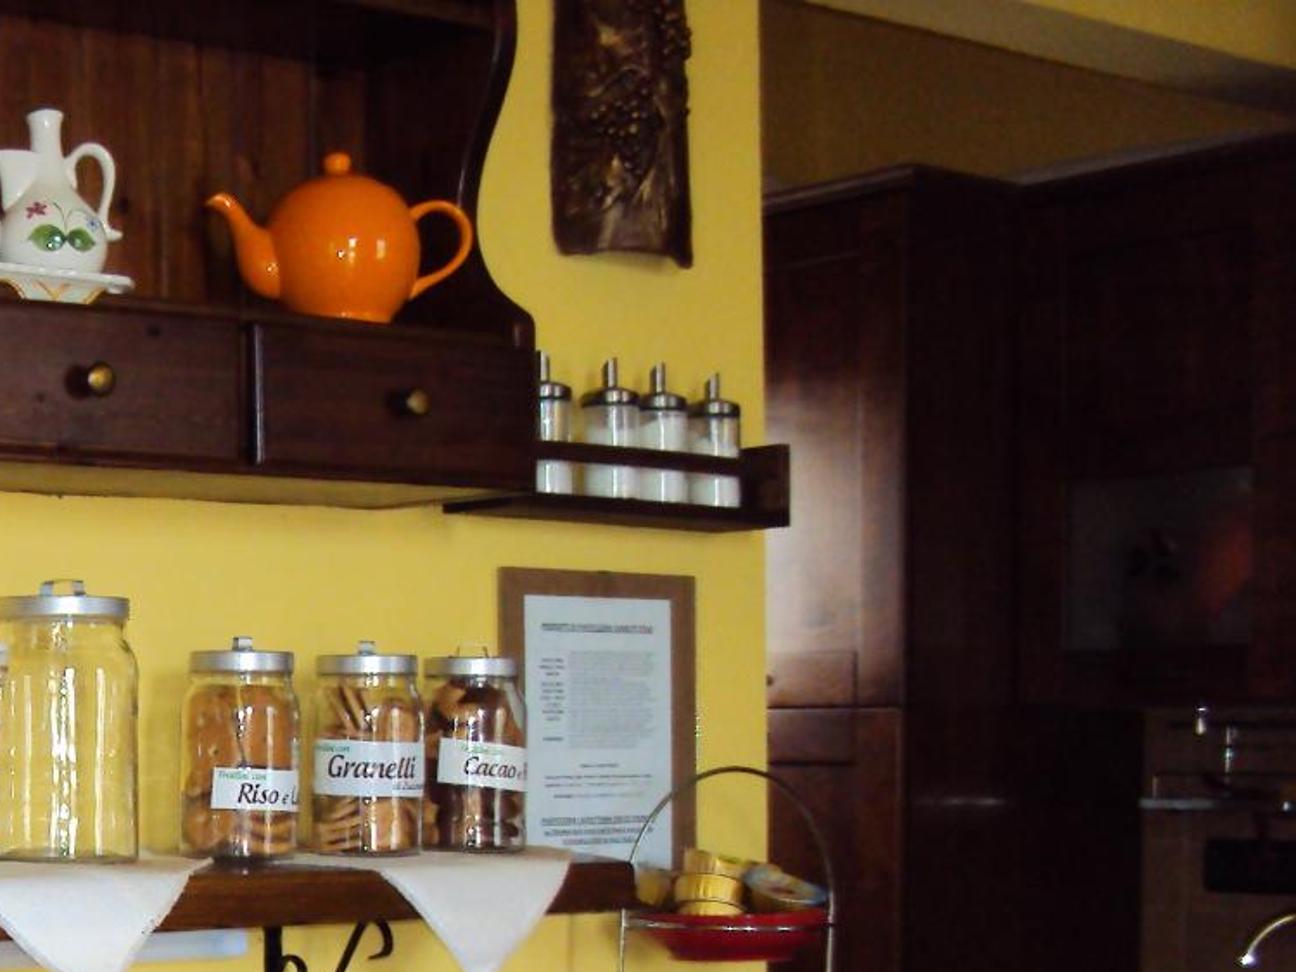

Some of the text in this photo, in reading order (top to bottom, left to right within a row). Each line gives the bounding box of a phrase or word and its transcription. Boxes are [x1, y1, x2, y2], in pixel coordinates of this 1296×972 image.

[327, 753, 417, 780] Granelli
[465, 755, 517, 779] Cacao
[237, 782, 279, 805] Riso
